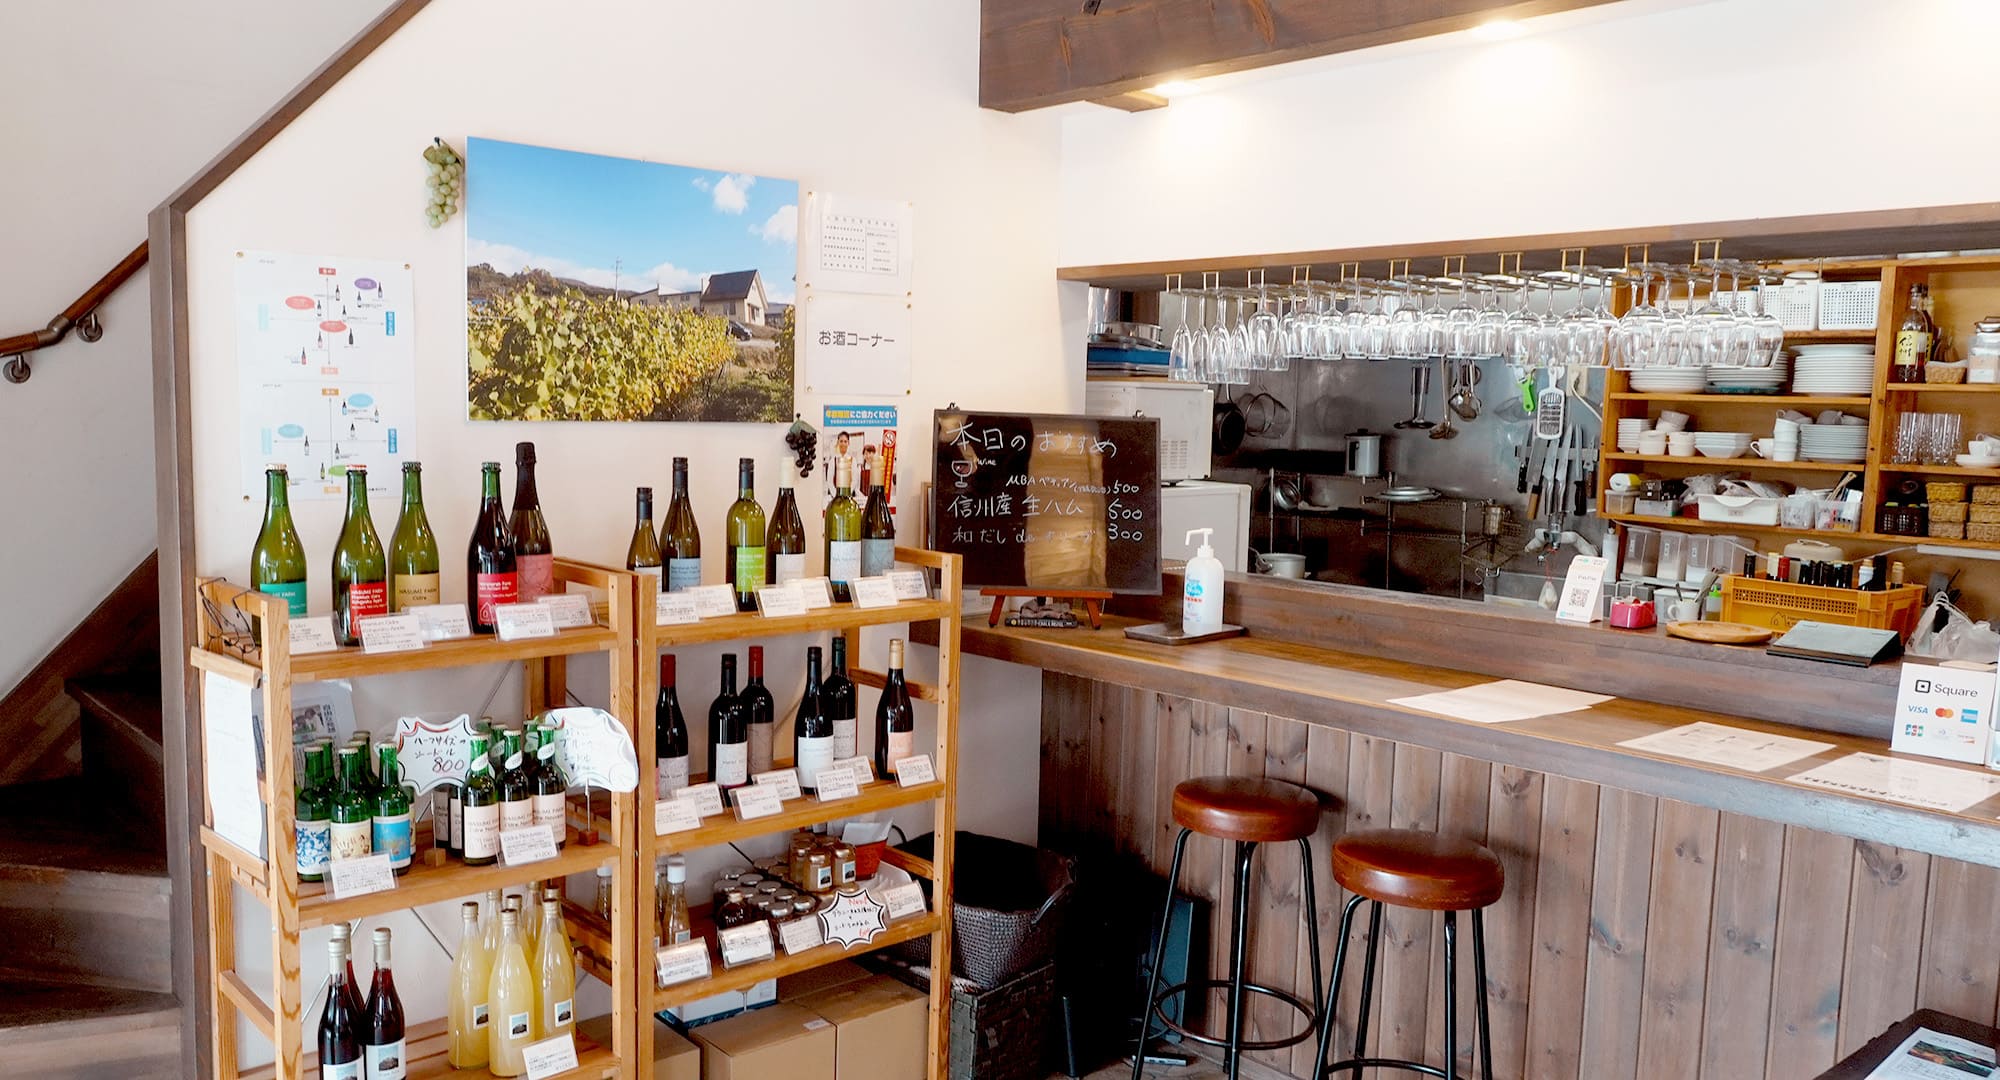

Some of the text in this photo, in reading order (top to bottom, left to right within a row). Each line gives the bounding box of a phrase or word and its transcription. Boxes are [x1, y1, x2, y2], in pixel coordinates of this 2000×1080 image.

[818, 330, 896, 348] お酒コーナー
[1112, 479, 1140, 494] 500
[947, 492, 1012, 518] 信州産
[1022, 493, 1083, 517] 生ハム
[1107, 523, 1143, 541] 300
[1934, 683, 1978, 698] Square
[1908, 705, 1929, 714] VISA
[432, 756, 465, 773] 800
